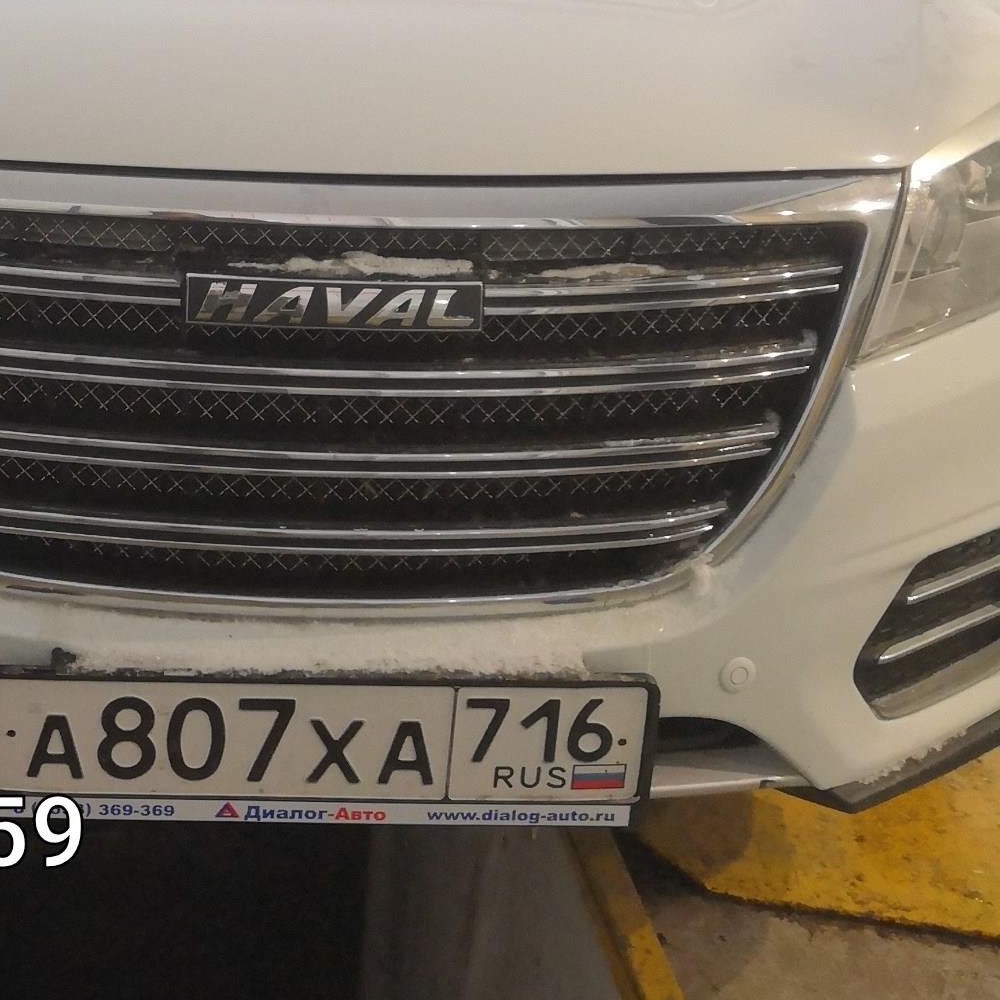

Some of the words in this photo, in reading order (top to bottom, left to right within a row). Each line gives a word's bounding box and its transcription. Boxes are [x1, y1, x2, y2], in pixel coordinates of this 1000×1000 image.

[196, 281, 474, 328] HAVAL
[465, 698, 613, 763] 716
[493, 766, 567, 788] RUS
[98, 804, 175, 817] 369-369
[244, 805, 386, 821] Диалог-Авто
[427, 809, 615, 823] www.dialog-auto.ru
